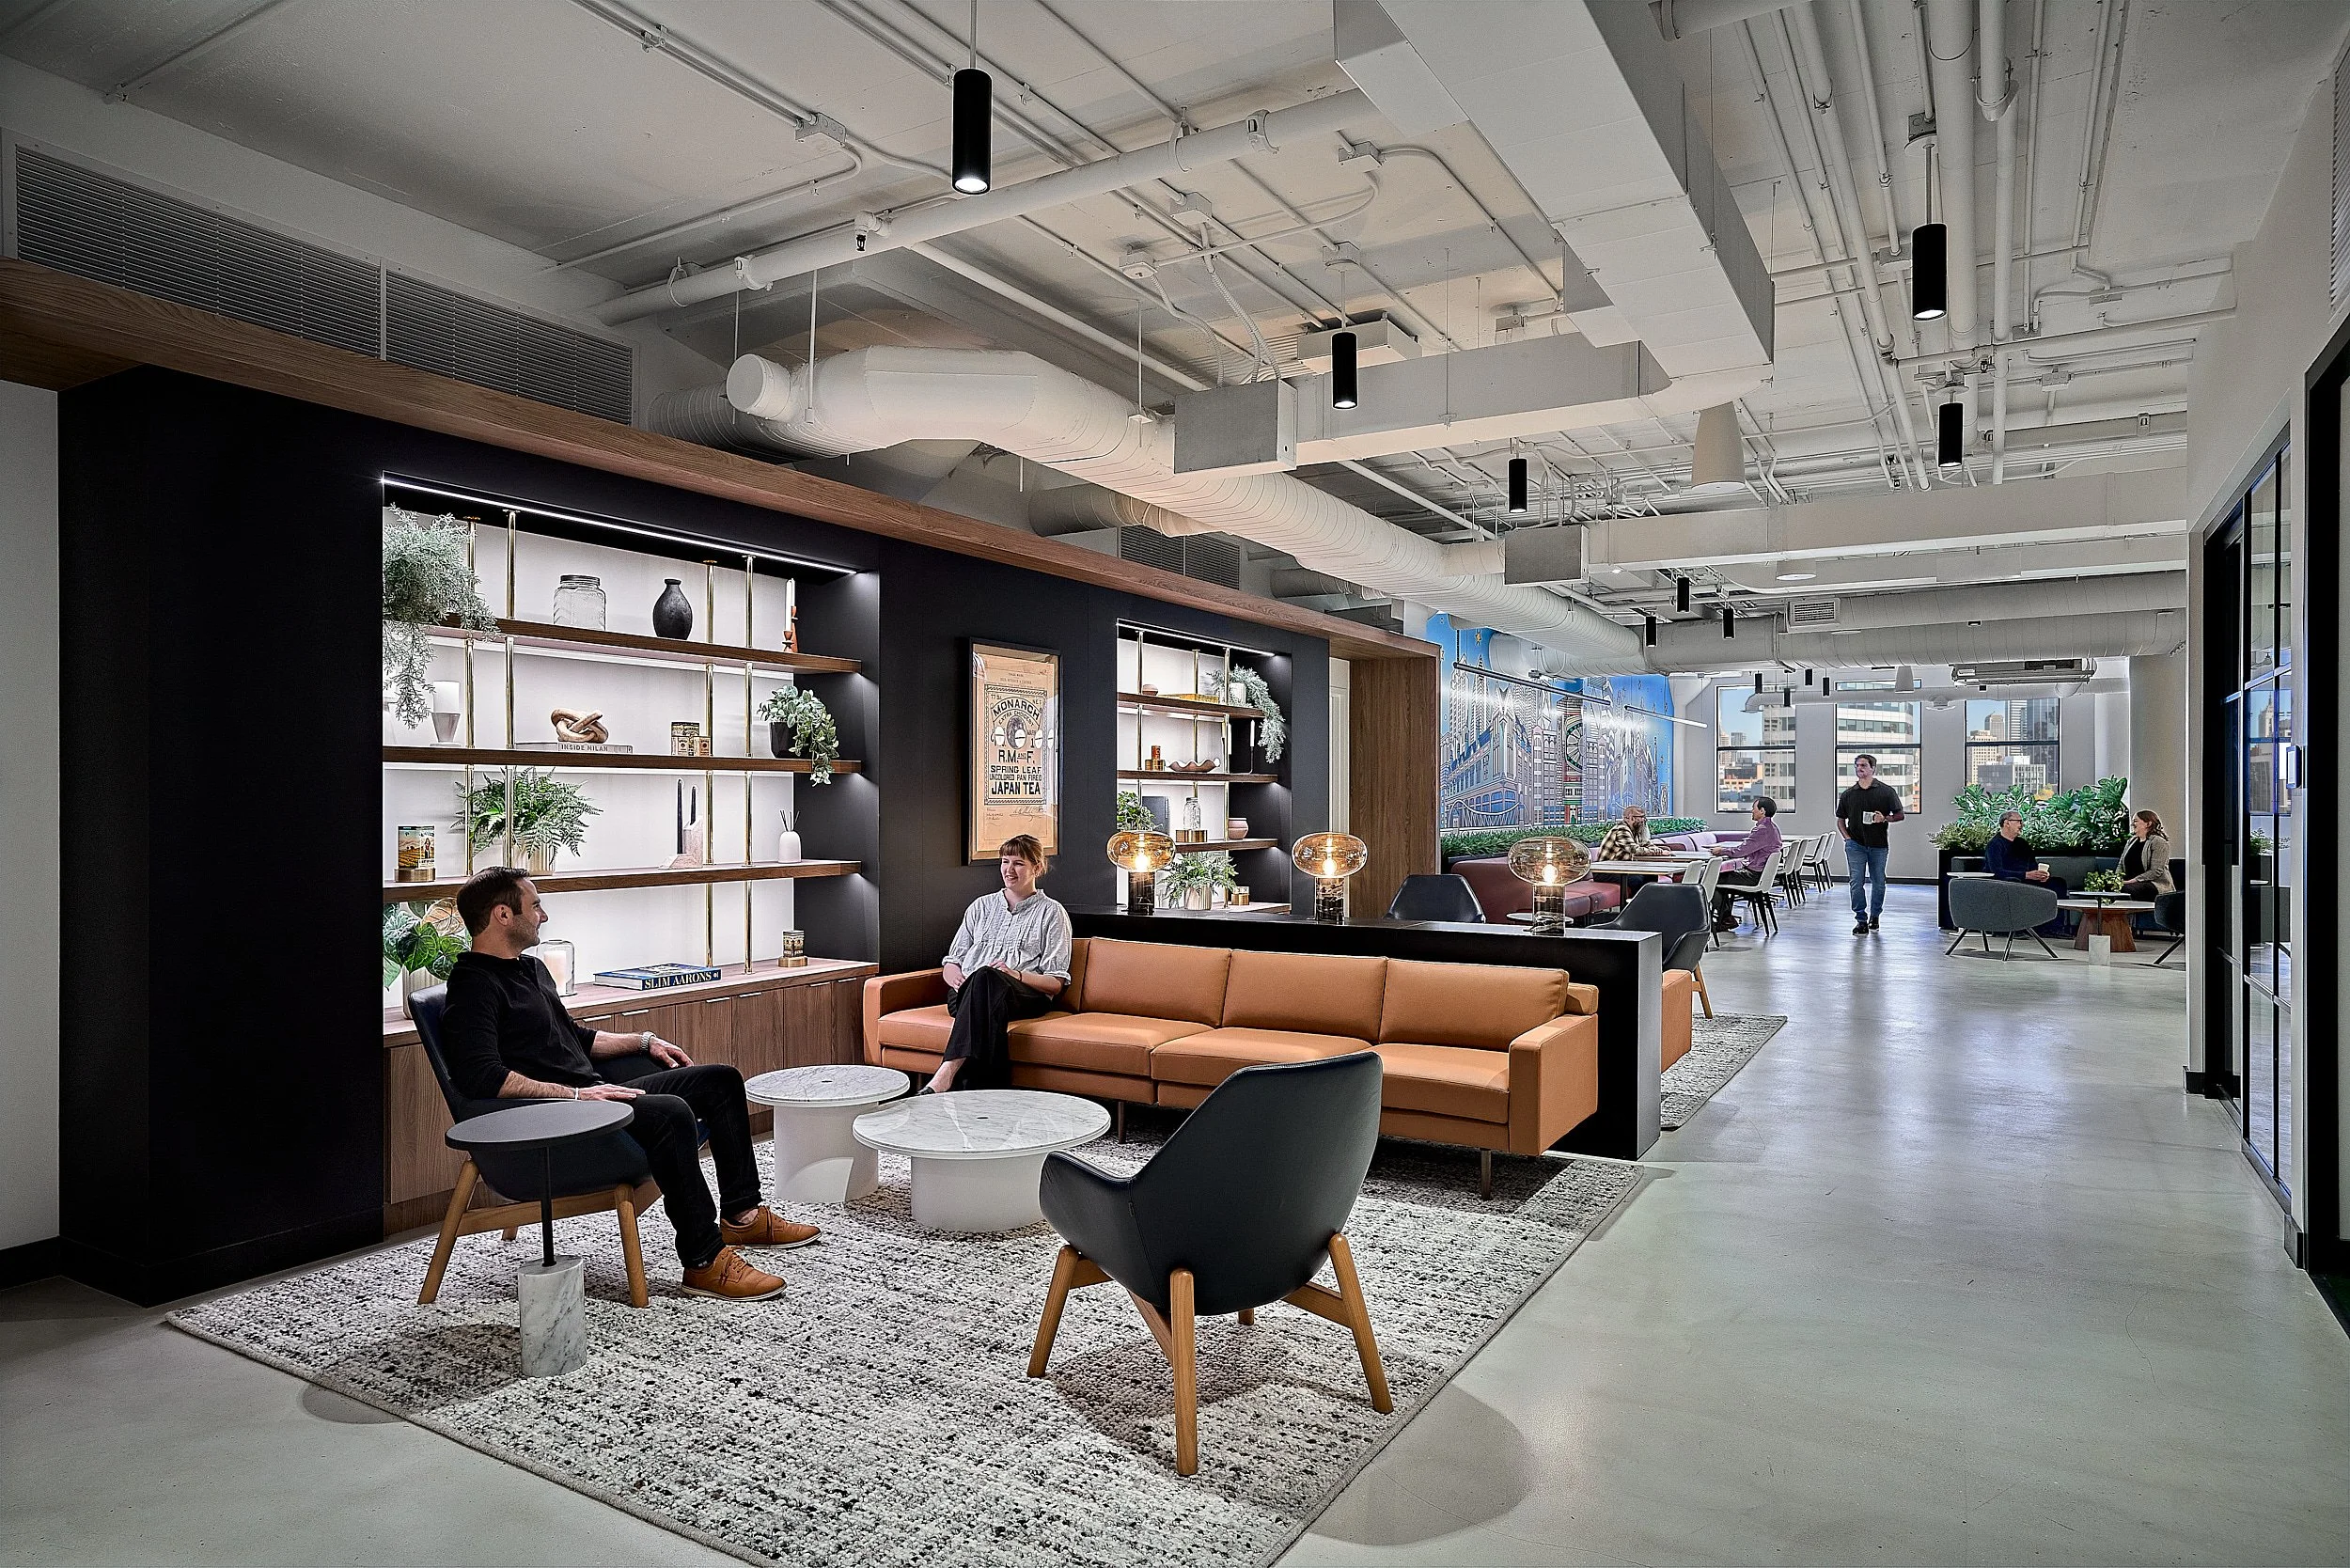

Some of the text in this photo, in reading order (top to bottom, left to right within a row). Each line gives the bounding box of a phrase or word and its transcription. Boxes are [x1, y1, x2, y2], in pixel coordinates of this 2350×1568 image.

[992, 698, 1040, 720] MONARCH
[998, 712, 1012, 726] EXTRA
[990, 765, 1019, 774] SPRING
[992, 781, 1041, 795] JAPAN TEA
[644, 976, 670, 990] SLIM
[672, 971, 712, 986] AARONS
